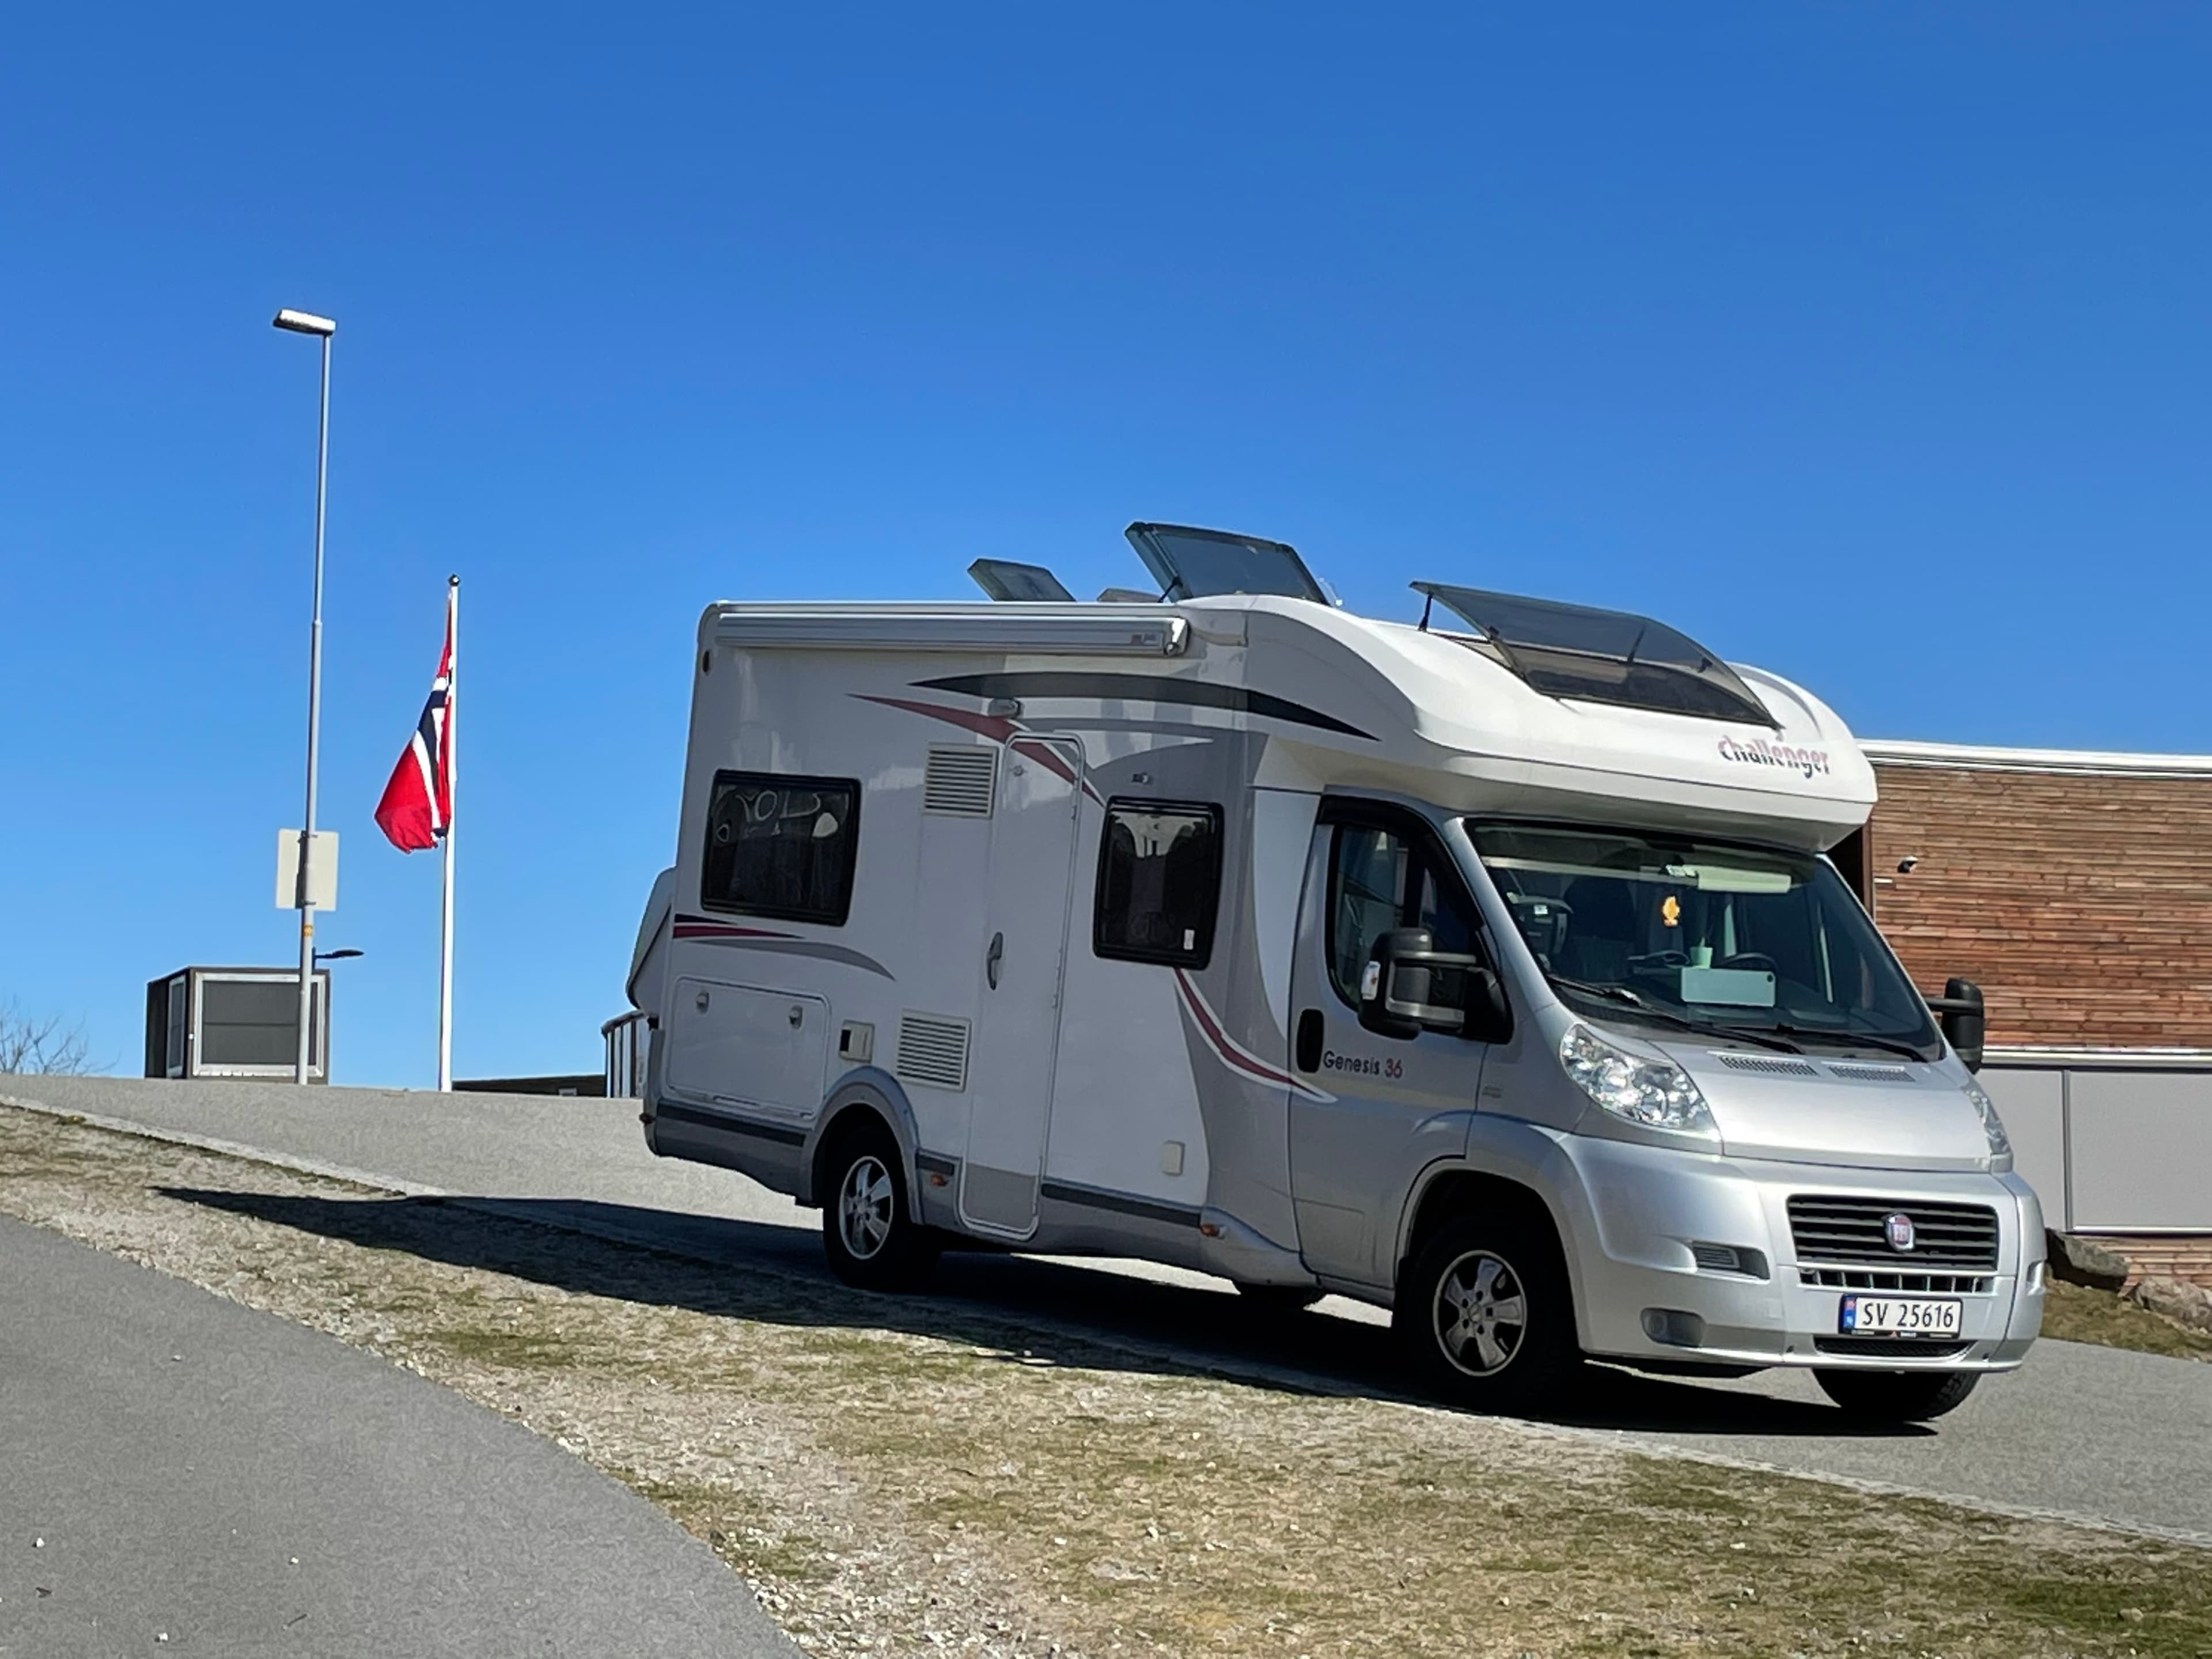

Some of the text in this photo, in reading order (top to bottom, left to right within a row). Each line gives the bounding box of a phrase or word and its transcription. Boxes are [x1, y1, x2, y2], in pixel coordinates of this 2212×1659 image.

[1323, 1050, 1403, 1078] Genesis 36
[1862, 1303, 1953, 1327] SV 25616
